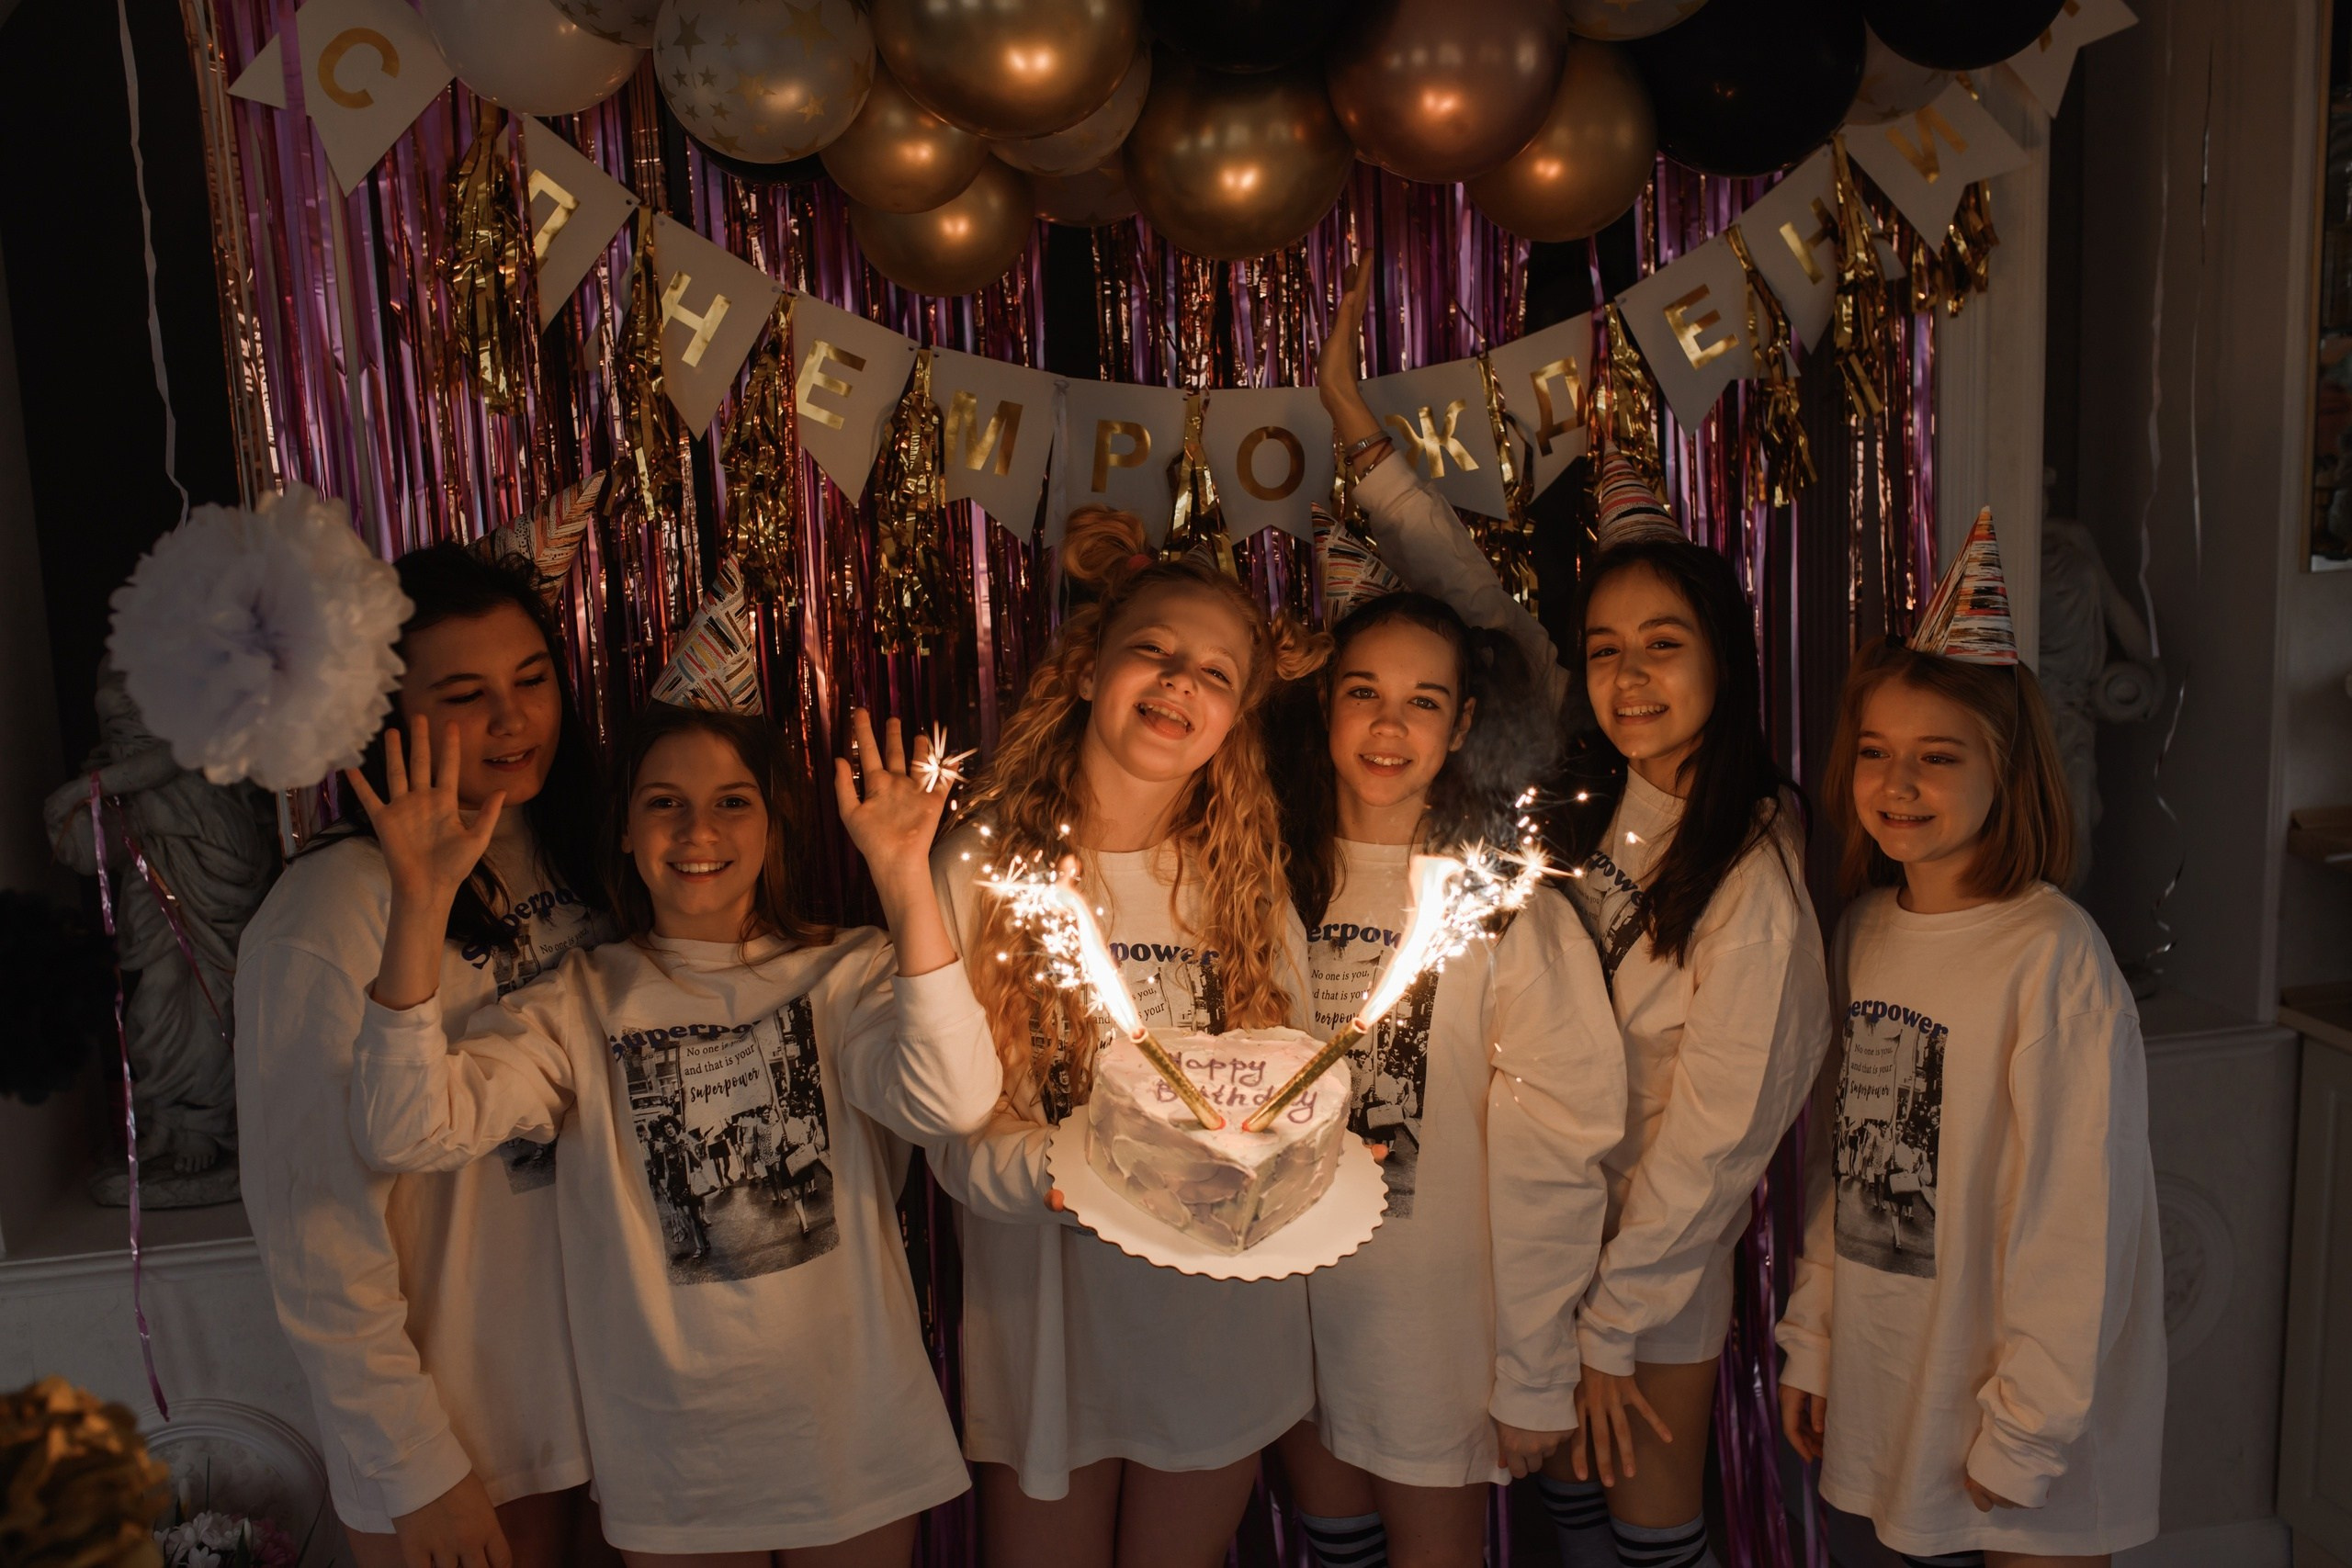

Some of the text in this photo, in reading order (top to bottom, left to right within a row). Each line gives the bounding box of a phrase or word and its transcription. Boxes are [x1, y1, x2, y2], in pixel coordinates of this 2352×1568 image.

[1091, 0, 2081, 502] РОЖДЕНИ
[539, 944, 553, 954] No
[554, 940, 568, 952] one
[567, 935, 575, 946] is
[1311, 969, 1370, 982] No one is you,
[1137, 987, 1157, 1001] you,
[1321, 989, 1339, 1000] that
[1340, 990, 1349, 1000] is
[1143, 1002, 1165, 1021] your
[686, 1047, 700, 1057] No
[702, 1043, 719, 1055] one
[1854, 1043, 1863, 1055] No
[1864, 1047, 1874, 1056] one
[1875, 1046, 1881, 1056] is
[684, 1043, 755, 1076] and that is your
[1850, 1062, 1894, 1077] and that is your
